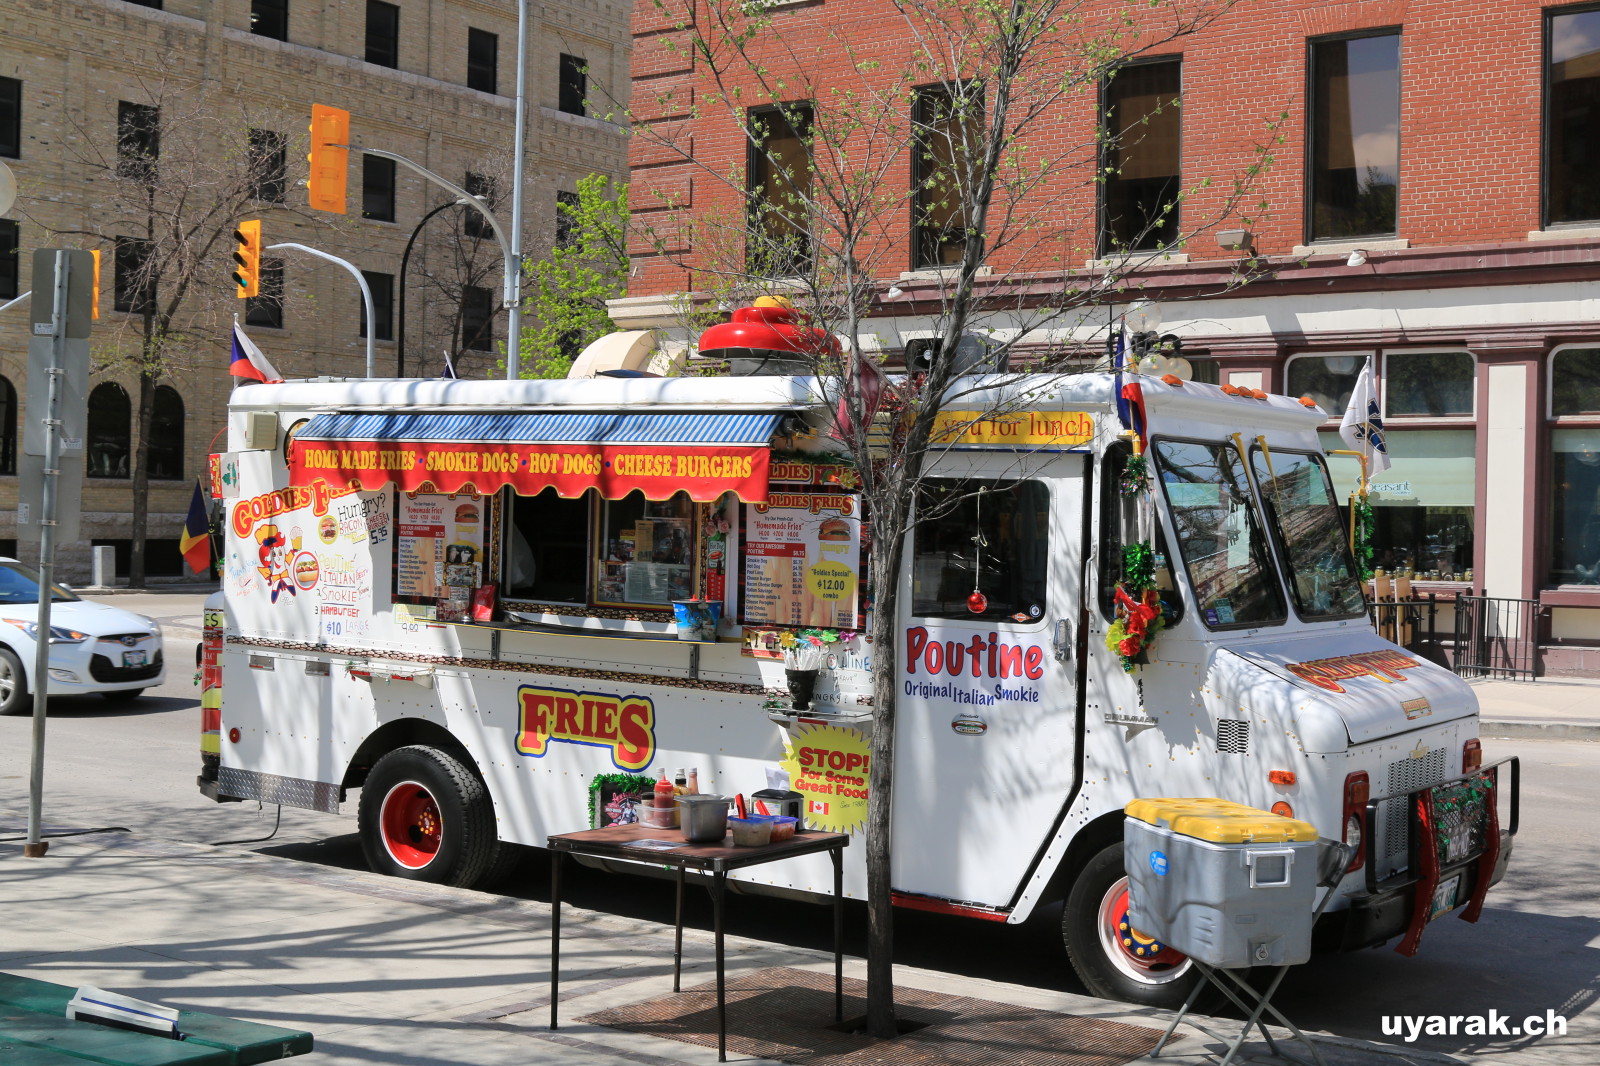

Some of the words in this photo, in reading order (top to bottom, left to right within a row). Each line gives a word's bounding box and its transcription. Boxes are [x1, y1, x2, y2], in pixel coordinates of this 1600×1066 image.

[990, 417, 1021, 436] for
[1030, 412, 1092, 437] lunch
[304, 449, 339, 469] HOME
[341, 450, 378, 470] MADE
[379, 450, 416, 470] FRIES
[425, 451, 478, 472] SMOKIE
[482, 452, 518, 473] DOGS
[528, 453, 560, 474] HOT
[562, 453, 602, 475] DOGS
[614, 454, 672, 476] CHEESE
[676, 455, 752, 478] BURGERS
[769, 463, 812, 481] LDIES
[232, 487, 313, 539] GOLDIES
[338, 492, 386, 522] Hungry?
[809, 494, 854, 516] FRIES
[906, 626, 1043, 680] Poutine
[904, 680, 952, 699] Original
[953, 687, 995, 706] Italian
[994, 683, 1039, 703] Smokie
[519, 691, 651, 765] FRIES
[799, 746, 870, 774] STOP!
[795, 778, 833, 794] Great
[836, 784, 869, 800] Food
[801, 766, 822, 780] For
[825, 770, 865, 787] Some
